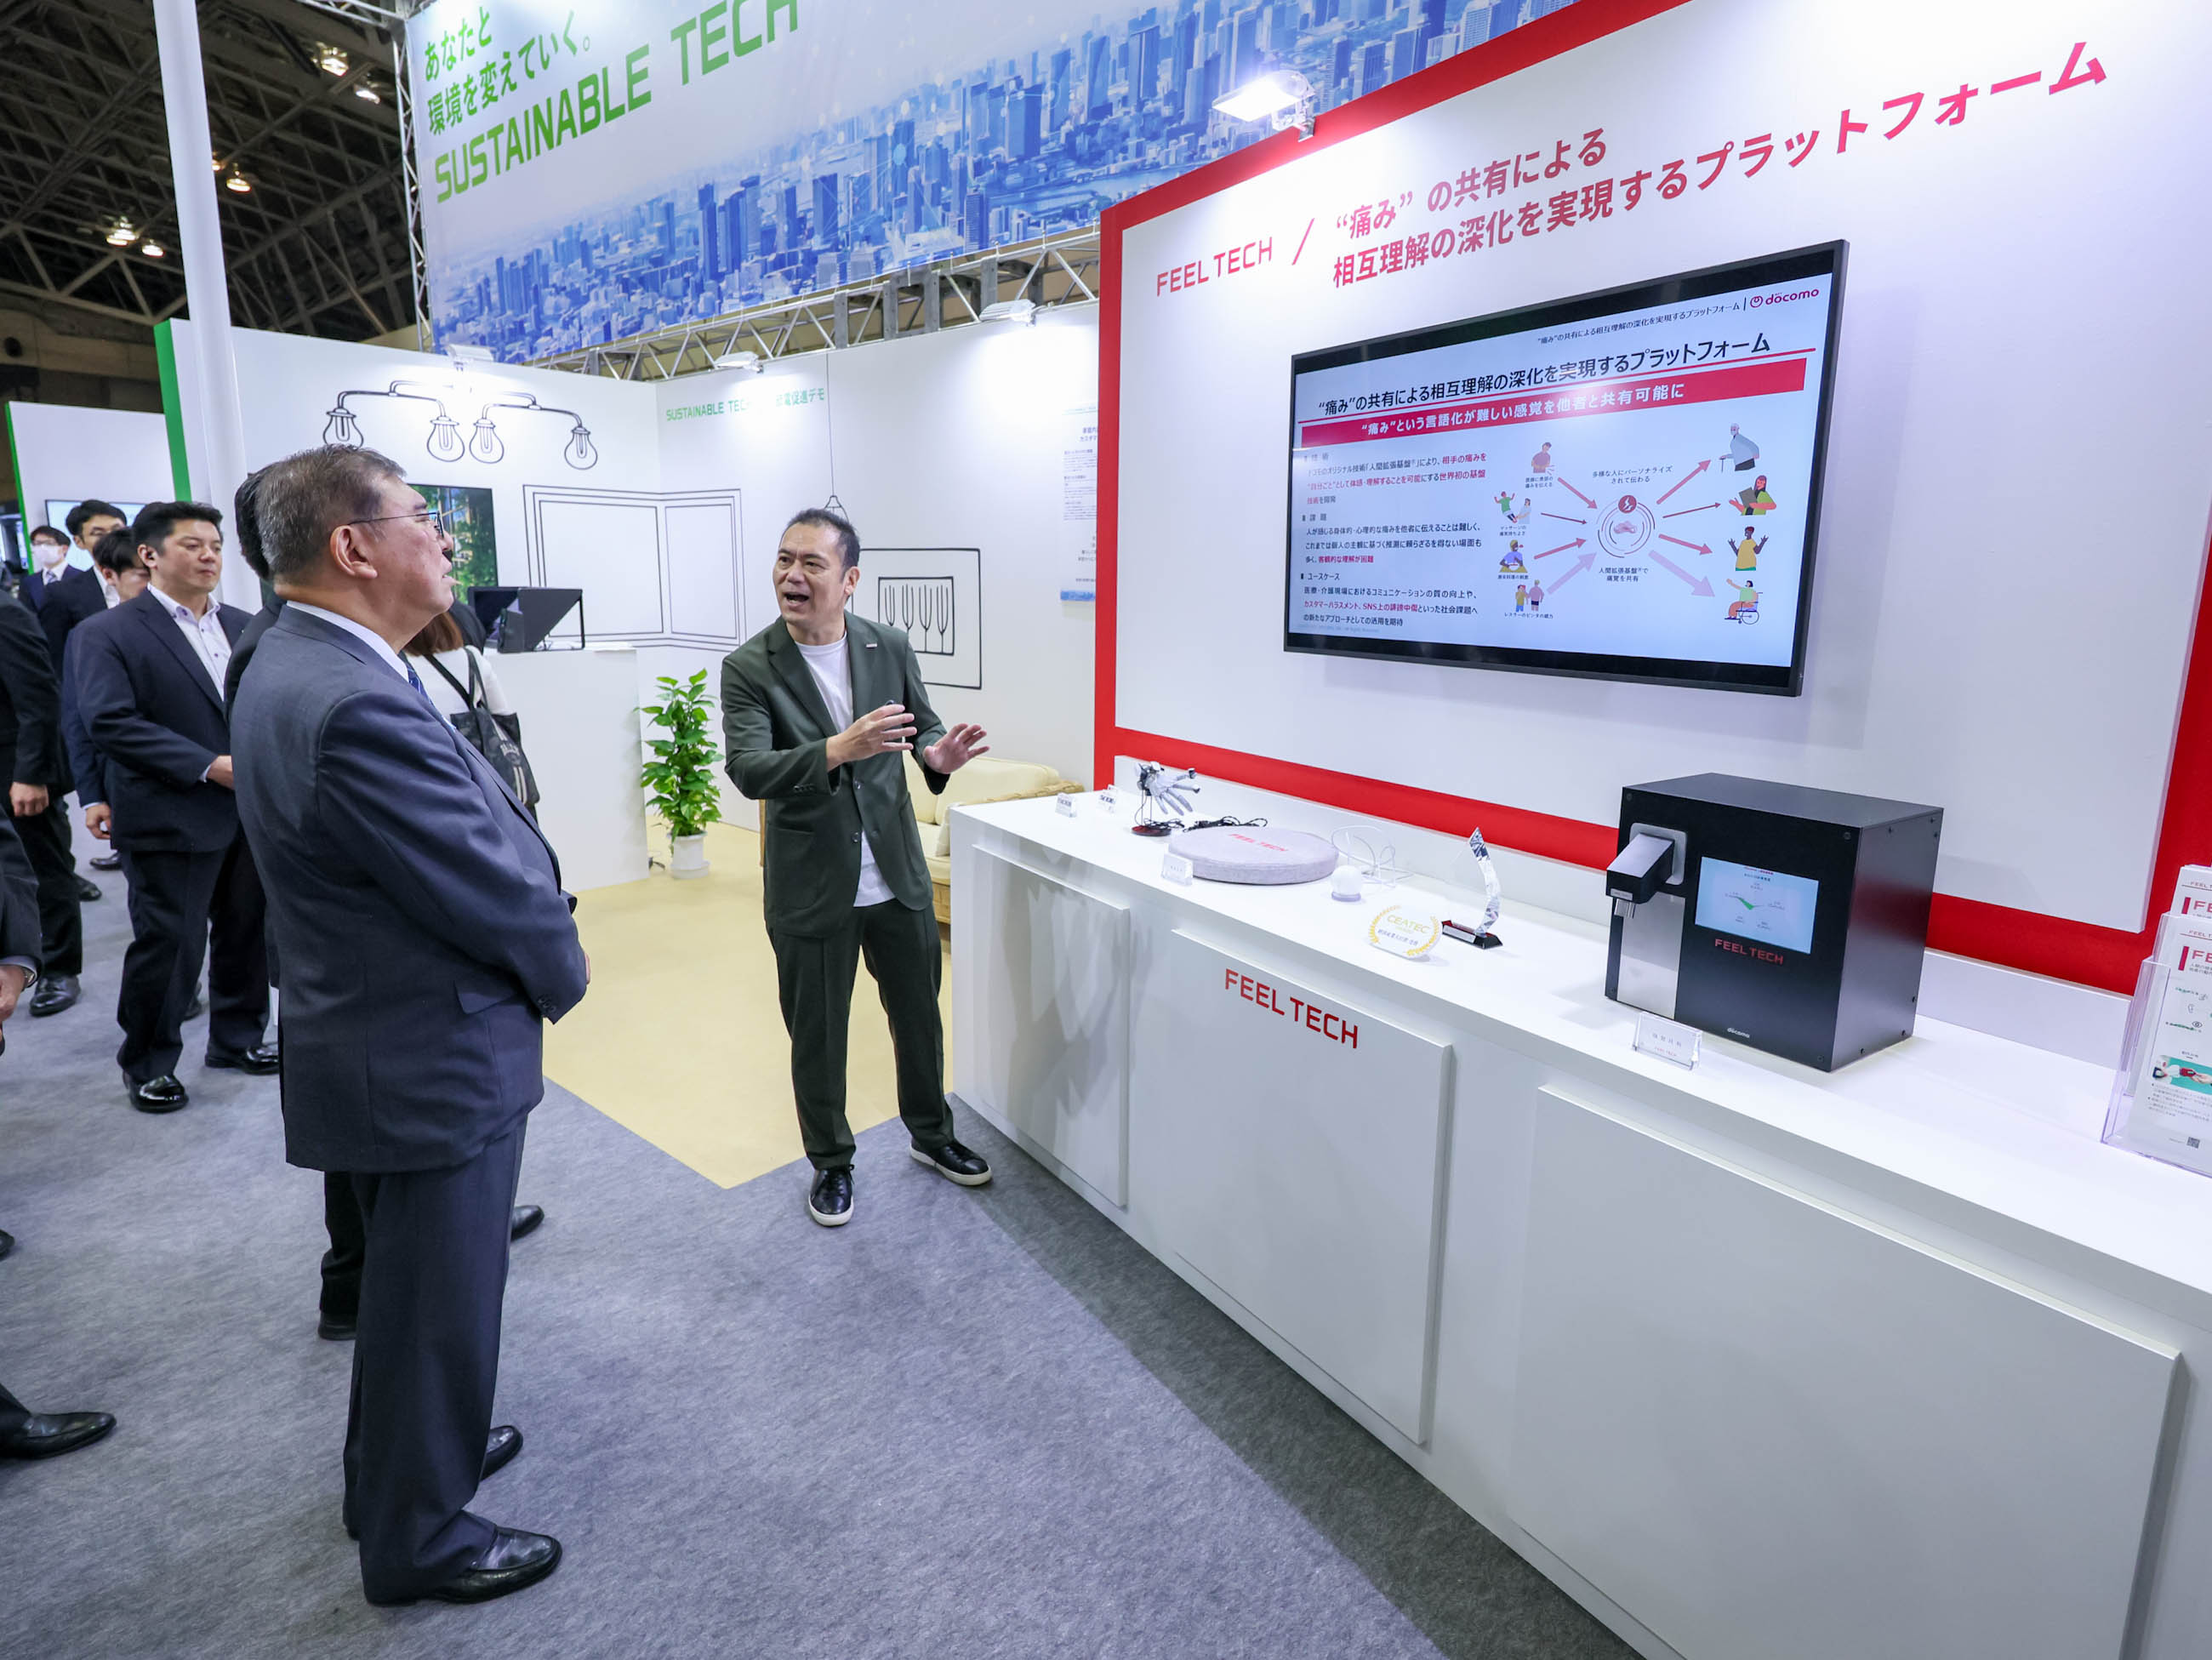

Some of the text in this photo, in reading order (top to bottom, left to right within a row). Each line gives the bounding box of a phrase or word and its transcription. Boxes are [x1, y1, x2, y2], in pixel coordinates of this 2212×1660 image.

[425, 7, 493, 81] あなたと
[427, 10, 590, 135] 環境を変えていく。
[436, 0, 799, 203] SUSTAINABLE TECH
[1333, 42, 2107, 288] 相互理解の深化を実現するプラットフォーム
[1156, 260, 1209, 297] FEEL
[1213, 236, 1273, 277] TECH
[1765, 288, 1819, 305] docomo
[666, 402, 724, 422] SUSTAINABLE
[1307, 572, 1341, 581] ユースケース
[1715, 938, 1784, 965] FEEL TECH
[1225, 968, 1359, 1049] FEEL TECH
